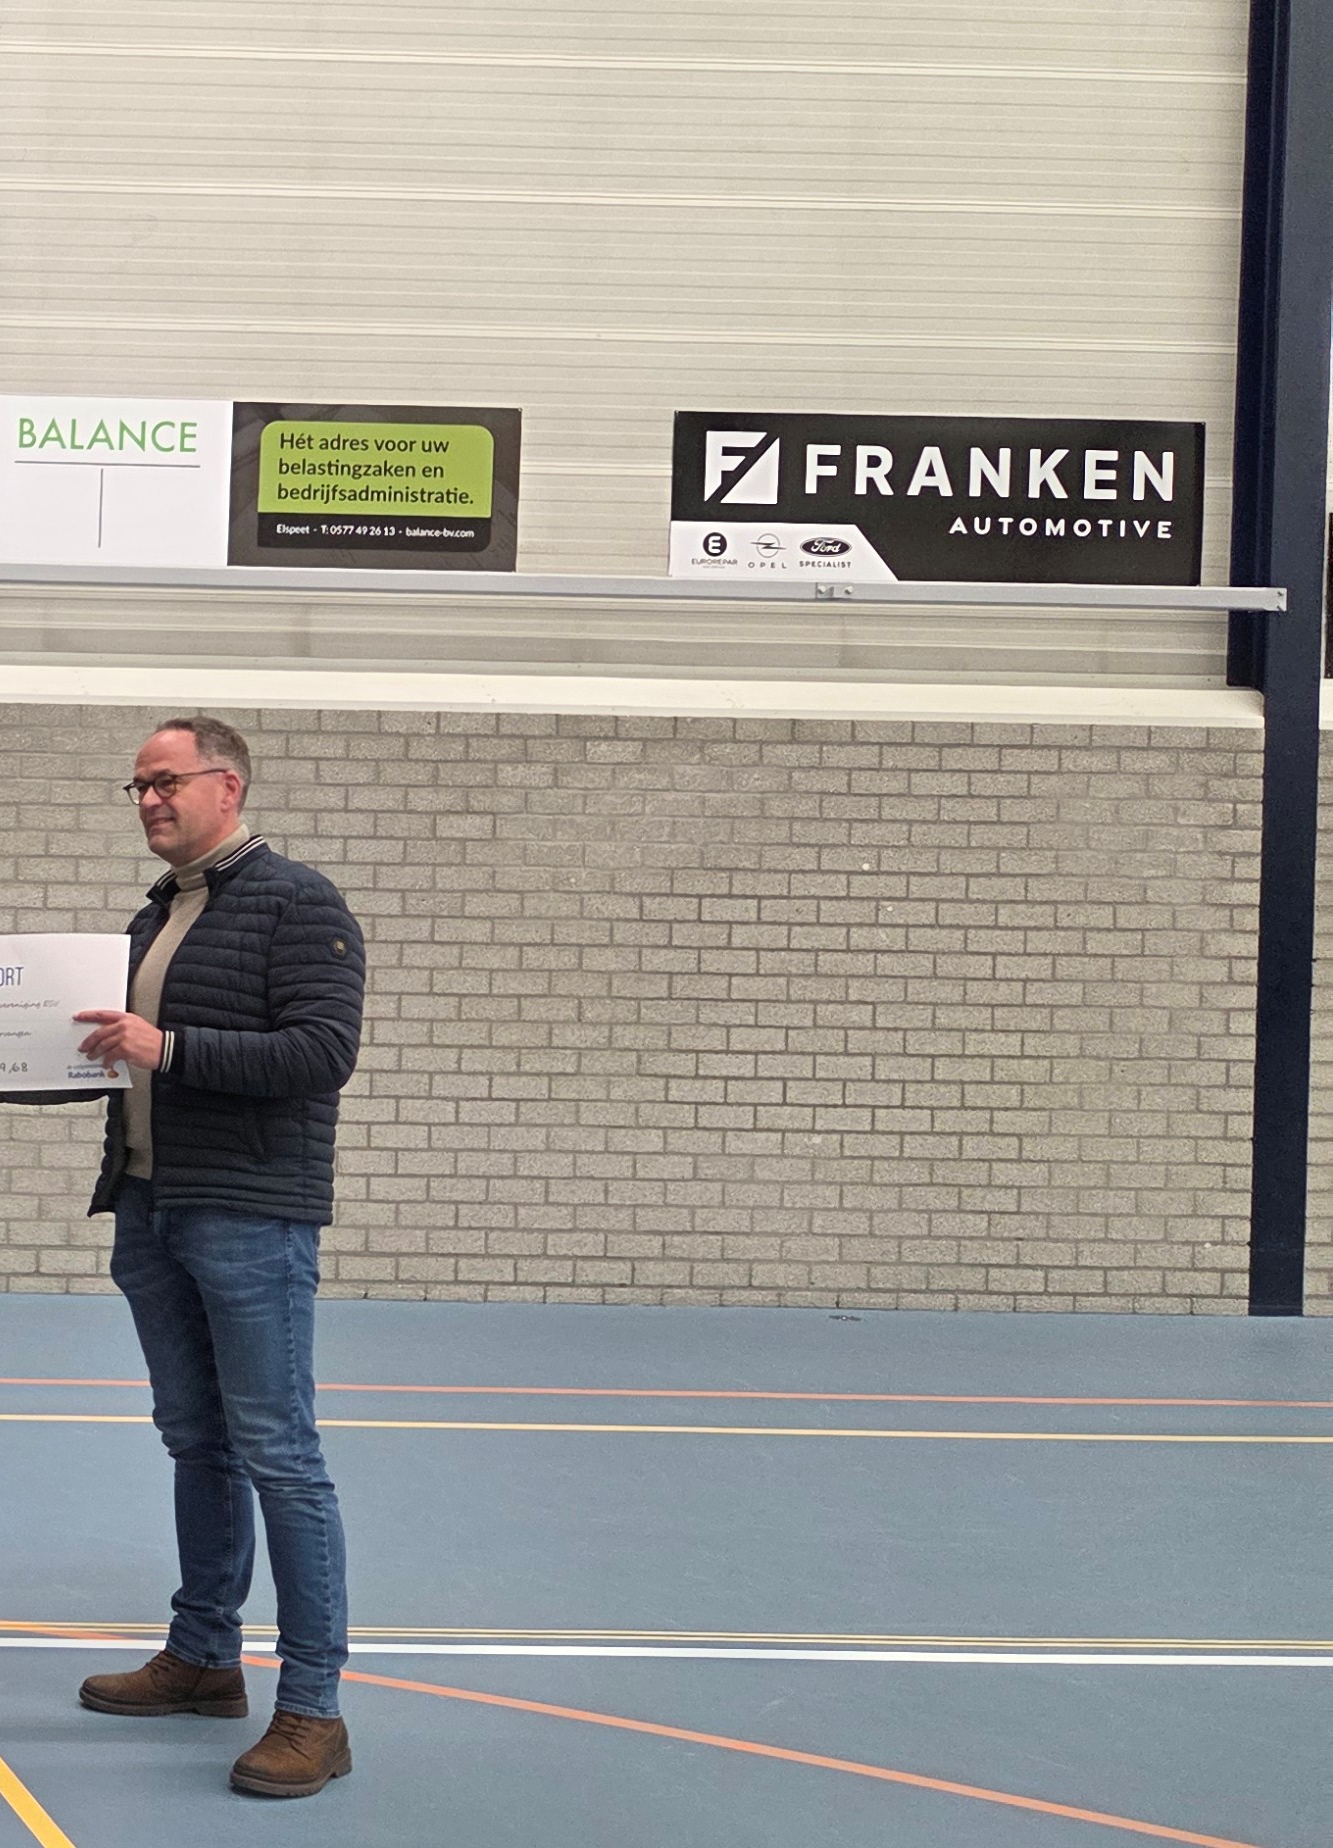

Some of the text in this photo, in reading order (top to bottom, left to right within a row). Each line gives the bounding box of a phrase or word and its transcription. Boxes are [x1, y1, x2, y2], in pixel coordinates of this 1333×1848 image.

[18, 418, 198, 453] BALANCE
[279, 431, 450, 453] Hét adres voor uw
[278, 457, 444, 481] belastingzaken en
[804, 443, 1174, 502] FRANKEN
[277, 482, 474, 505] bedrijfsadministratie.
[276, 523, 310, 536] Elspeet
[330, 524, 354, 535] 0577
[355, 525, 368, 535] 49
[369, 525, 381, 536] 26
[383, 526, 396, 536] 13
[405, 526, 475, 538] balance-bv.com
[949, 516, 1173, 539] AUTOMOTIVE
[748, 561, 787, 569] OPEL
[799, 560, 852, 568] SPECIALIST
